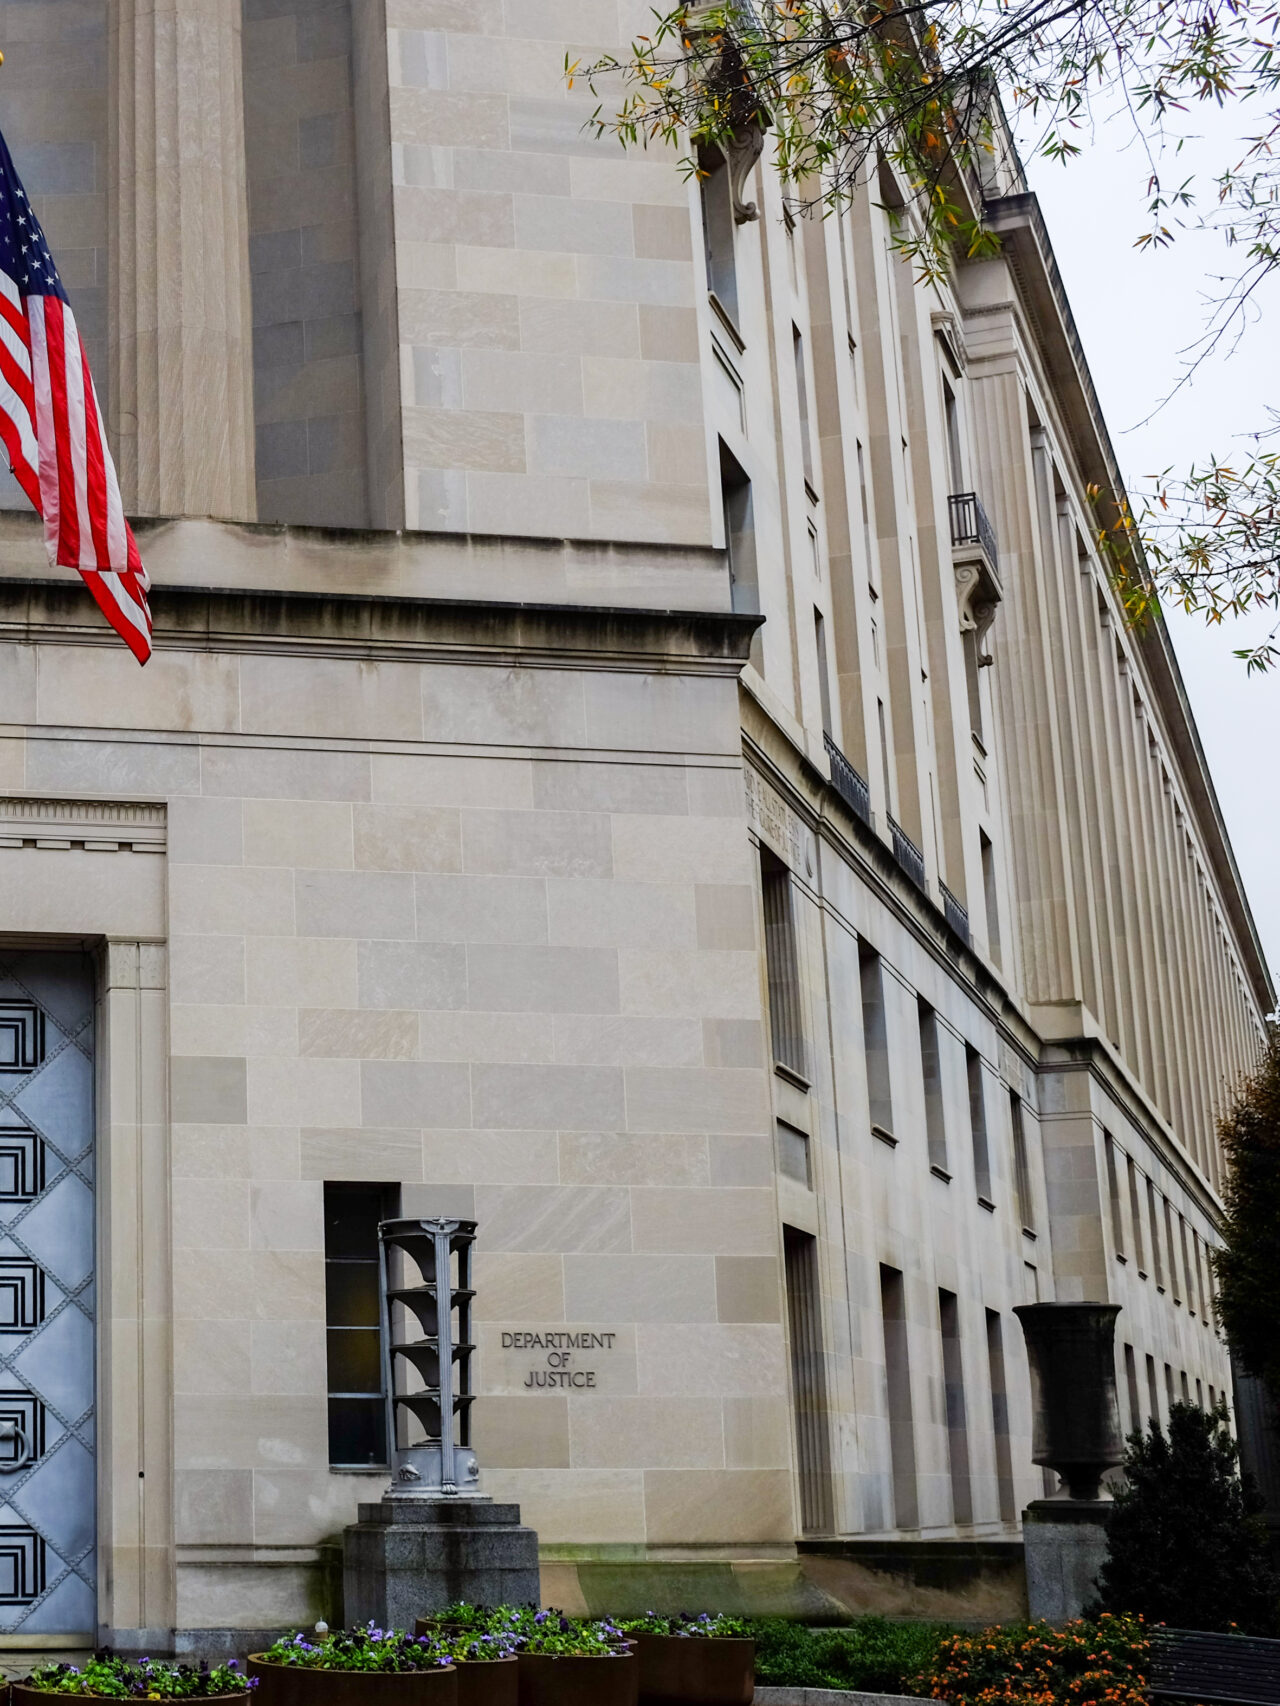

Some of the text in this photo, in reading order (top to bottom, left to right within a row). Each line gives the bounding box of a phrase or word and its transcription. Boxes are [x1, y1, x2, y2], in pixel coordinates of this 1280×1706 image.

[501, 1332, 616, 1349] DEPARTMENT
[547, 1351, 571, 1368] OF
[524, 1371, 597, 1388] JUSTICE
